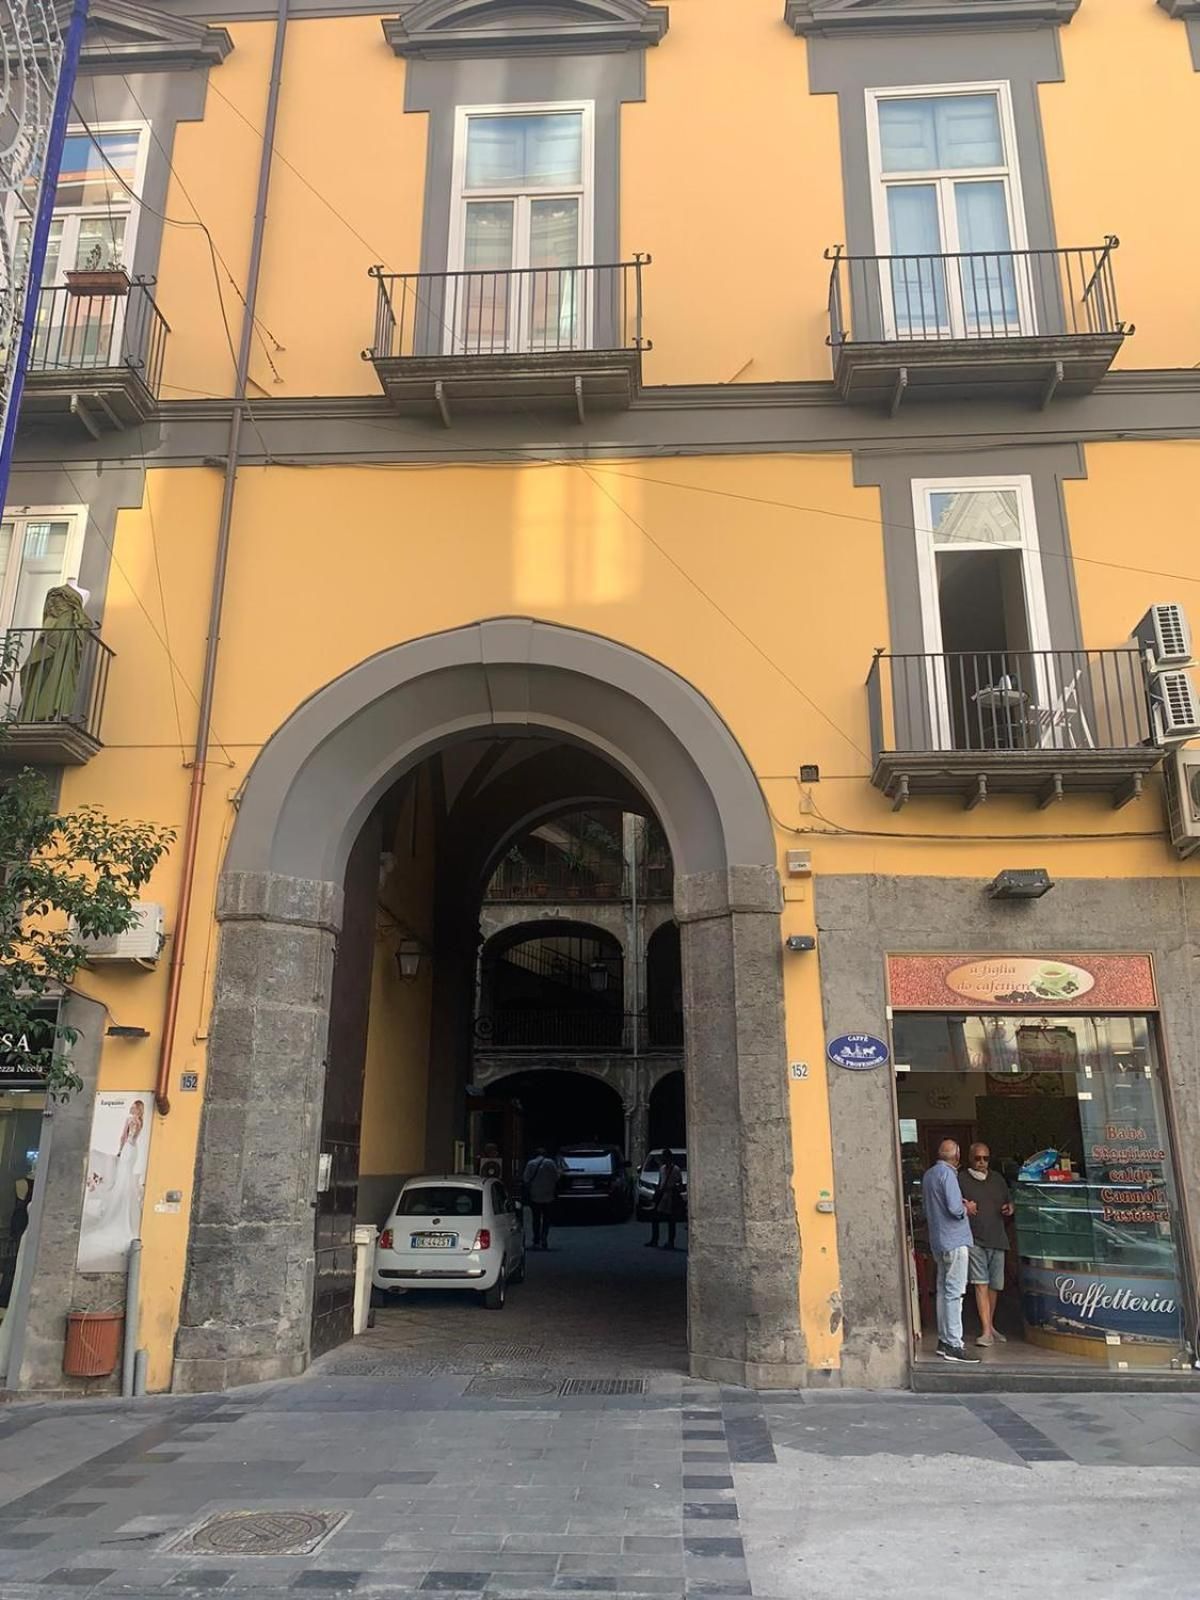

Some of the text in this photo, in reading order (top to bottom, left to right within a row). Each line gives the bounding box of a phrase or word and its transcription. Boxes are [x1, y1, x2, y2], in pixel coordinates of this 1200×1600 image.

[792, 1063, 809, 1078] 152
[182, 1075, 198, 1089] 152
[1101, 1188, 1168, 1204] Cannoli
[1103, 1205, 1171, 1223] Pastiere
[1055, 1276, 1176, 1319] Caffetteria
